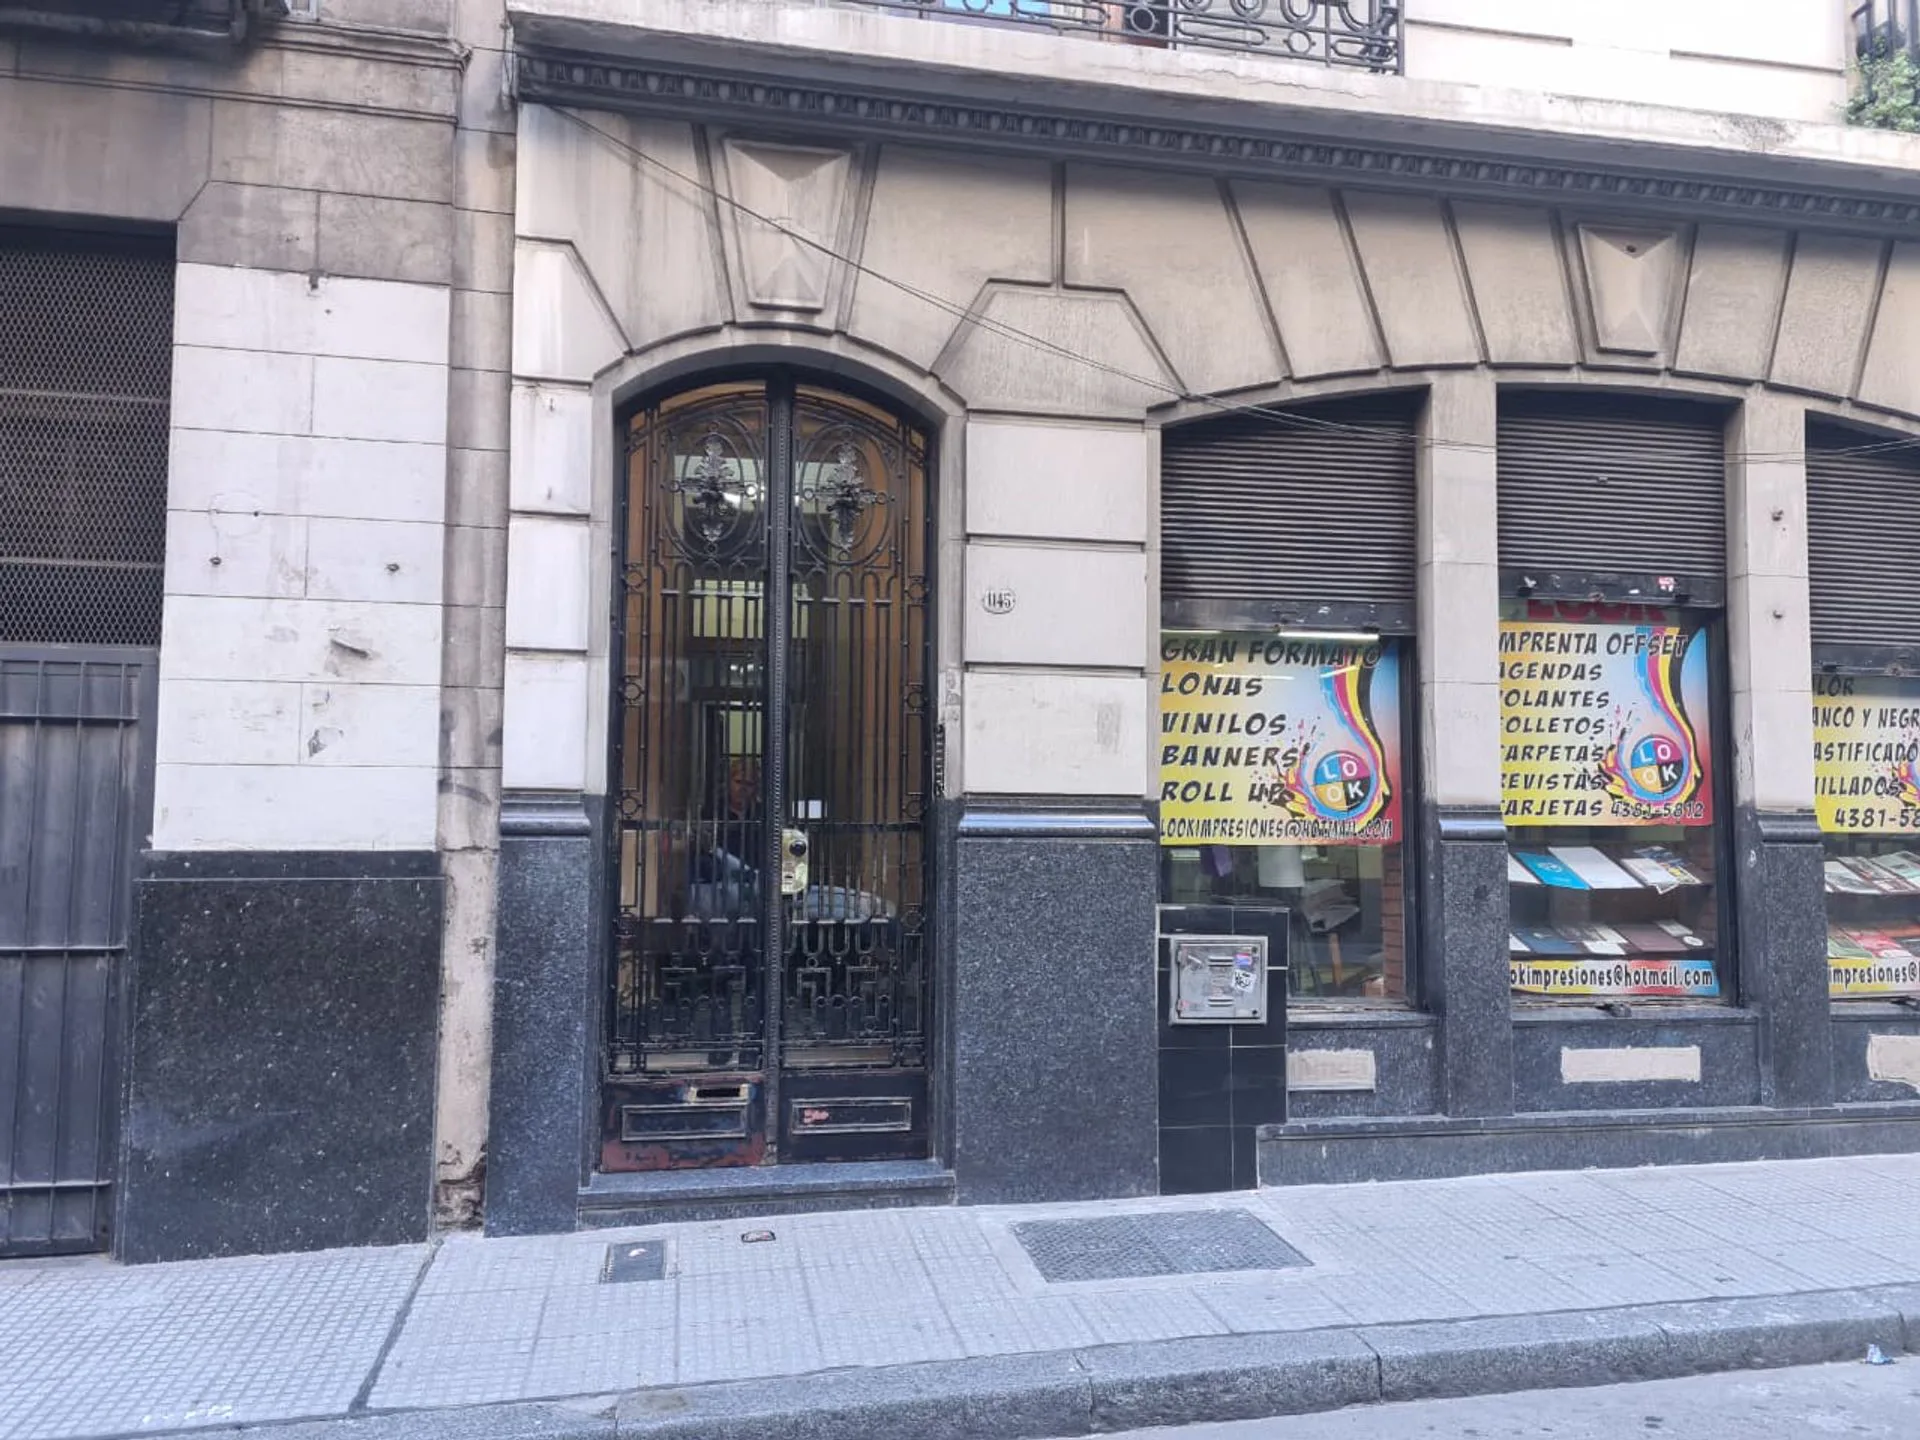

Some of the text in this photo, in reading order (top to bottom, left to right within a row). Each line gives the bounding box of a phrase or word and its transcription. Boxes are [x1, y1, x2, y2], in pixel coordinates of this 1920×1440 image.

[988, 591, 1011, 608] 1145
[1161, 638, 1381, 668] GRAN FORMATO
[1606, 632, 1688, 657] OFFSET
[1162, 672, 1263, 697] LONAS
[1812, 674, 1855, 696] LOR
[1500, 688, 1609, 709] OLANTES
[1162, 712, 1286, 735] VINILOS
[1500, 716, 1604, 735] OLLETOS
[1863, 708, 1871, 728] Y
[1161, 745, 1298, 768] BANNERS
[1500, 744, 1604, 763] ARPETAS
[1161, 781, 1285, 803] ROLL UP
[1501, 799, 1602, 816] ARJETAS
[1161, 817, 1393, 840] LOOKIMPRESIONES@HOTMAIL.COM
